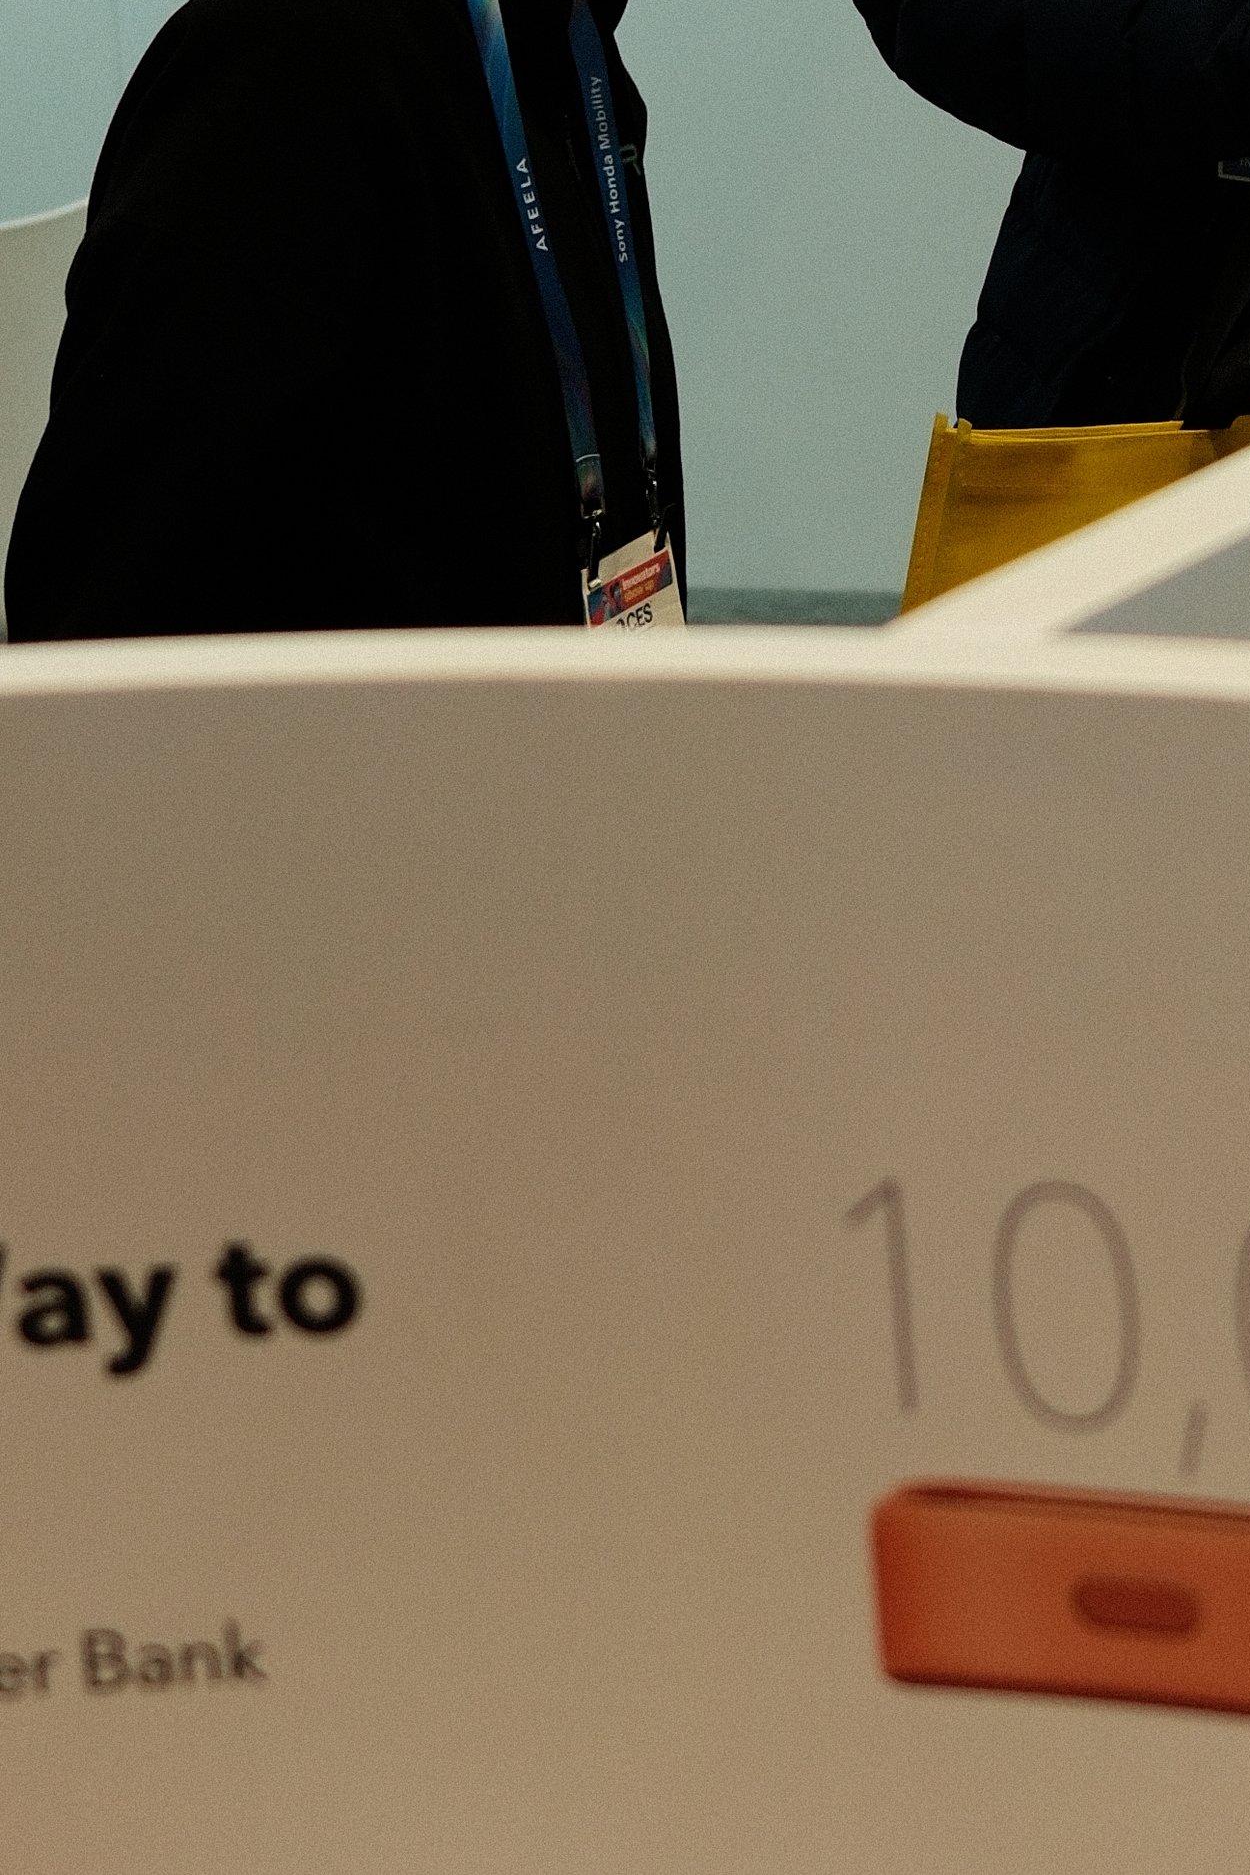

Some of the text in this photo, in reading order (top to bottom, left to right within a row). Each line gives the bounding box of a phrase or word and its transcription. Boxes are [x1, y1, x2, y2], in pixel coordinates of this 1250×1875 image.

[516, 156, 549, 252] AFEELA
[589, 76, 628, 264] Sony Honda Mobility
[0, 1239, 362, 1378] ay to
[79, 1619, 268, 1696] Bank
